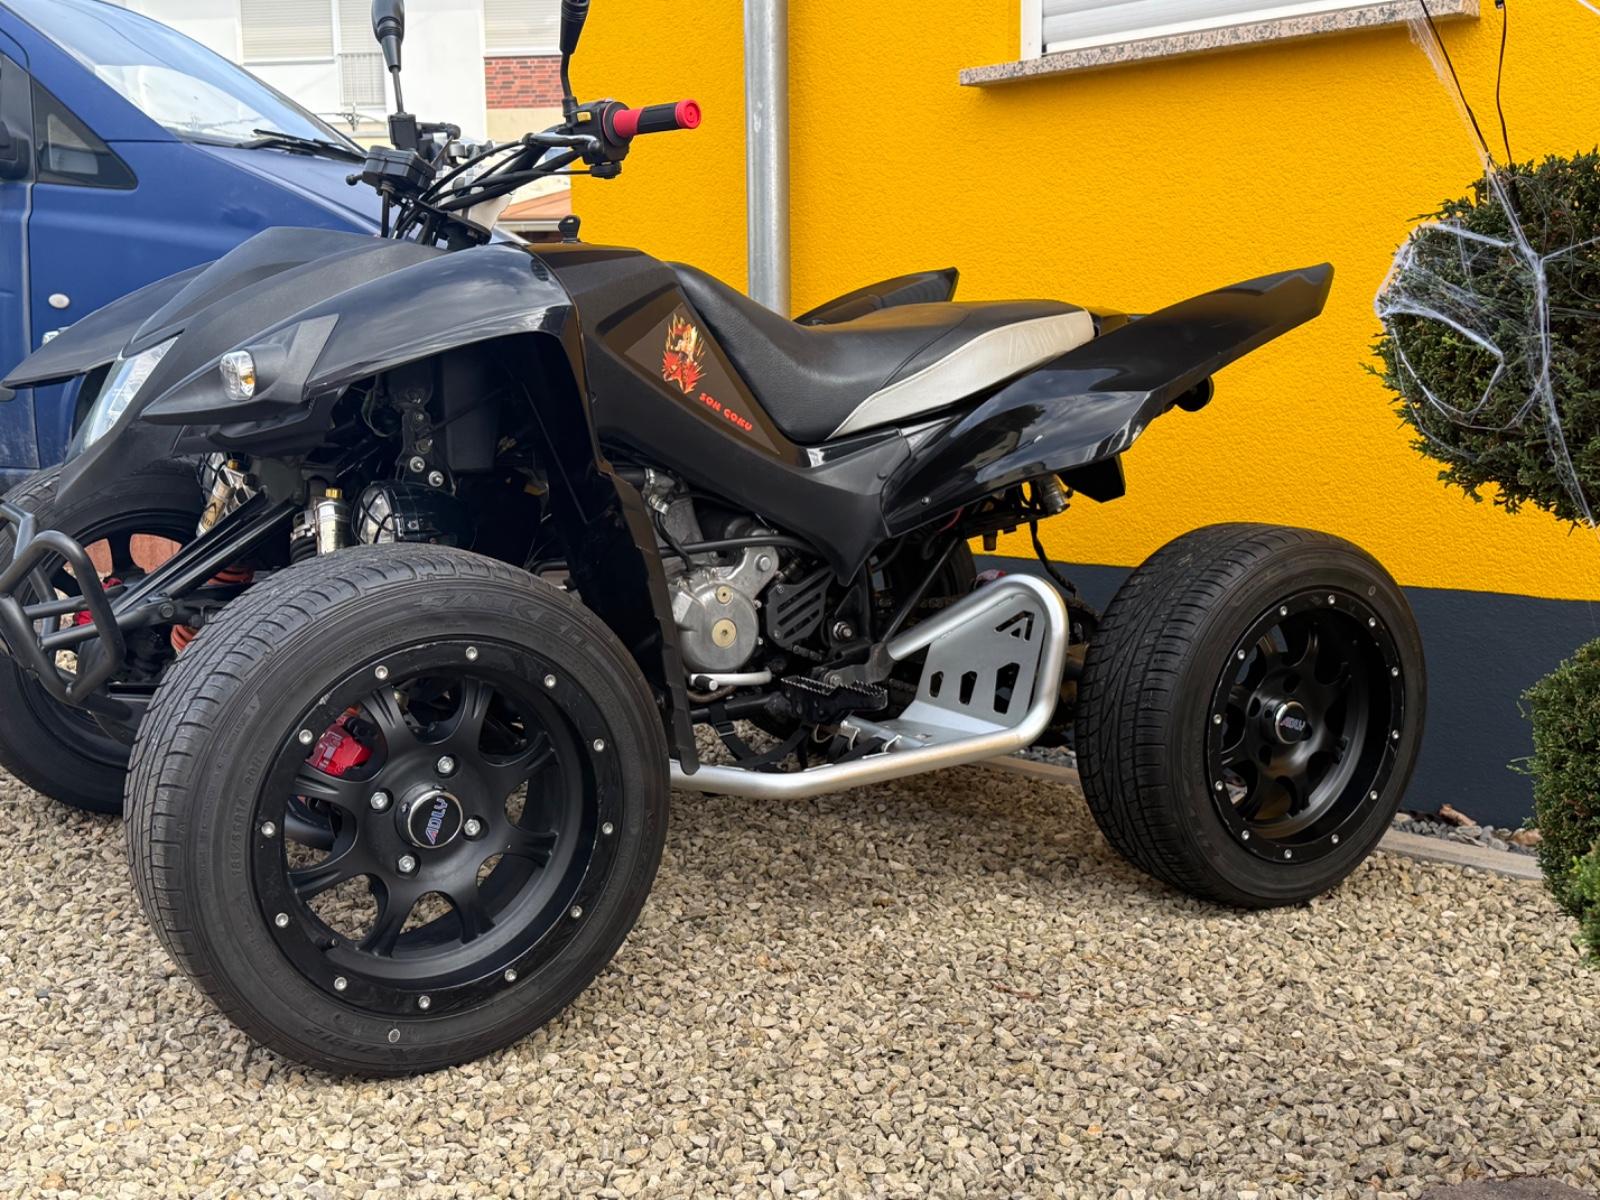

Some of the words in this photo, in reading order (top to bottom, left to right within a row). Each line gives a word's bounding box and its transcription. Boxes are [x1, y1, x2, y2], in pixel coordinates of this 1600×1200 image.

[699, 392, 721, 412] SON
[723, 408, 753, 432] GOKU
[425, 796, 448, 846] ADLY
